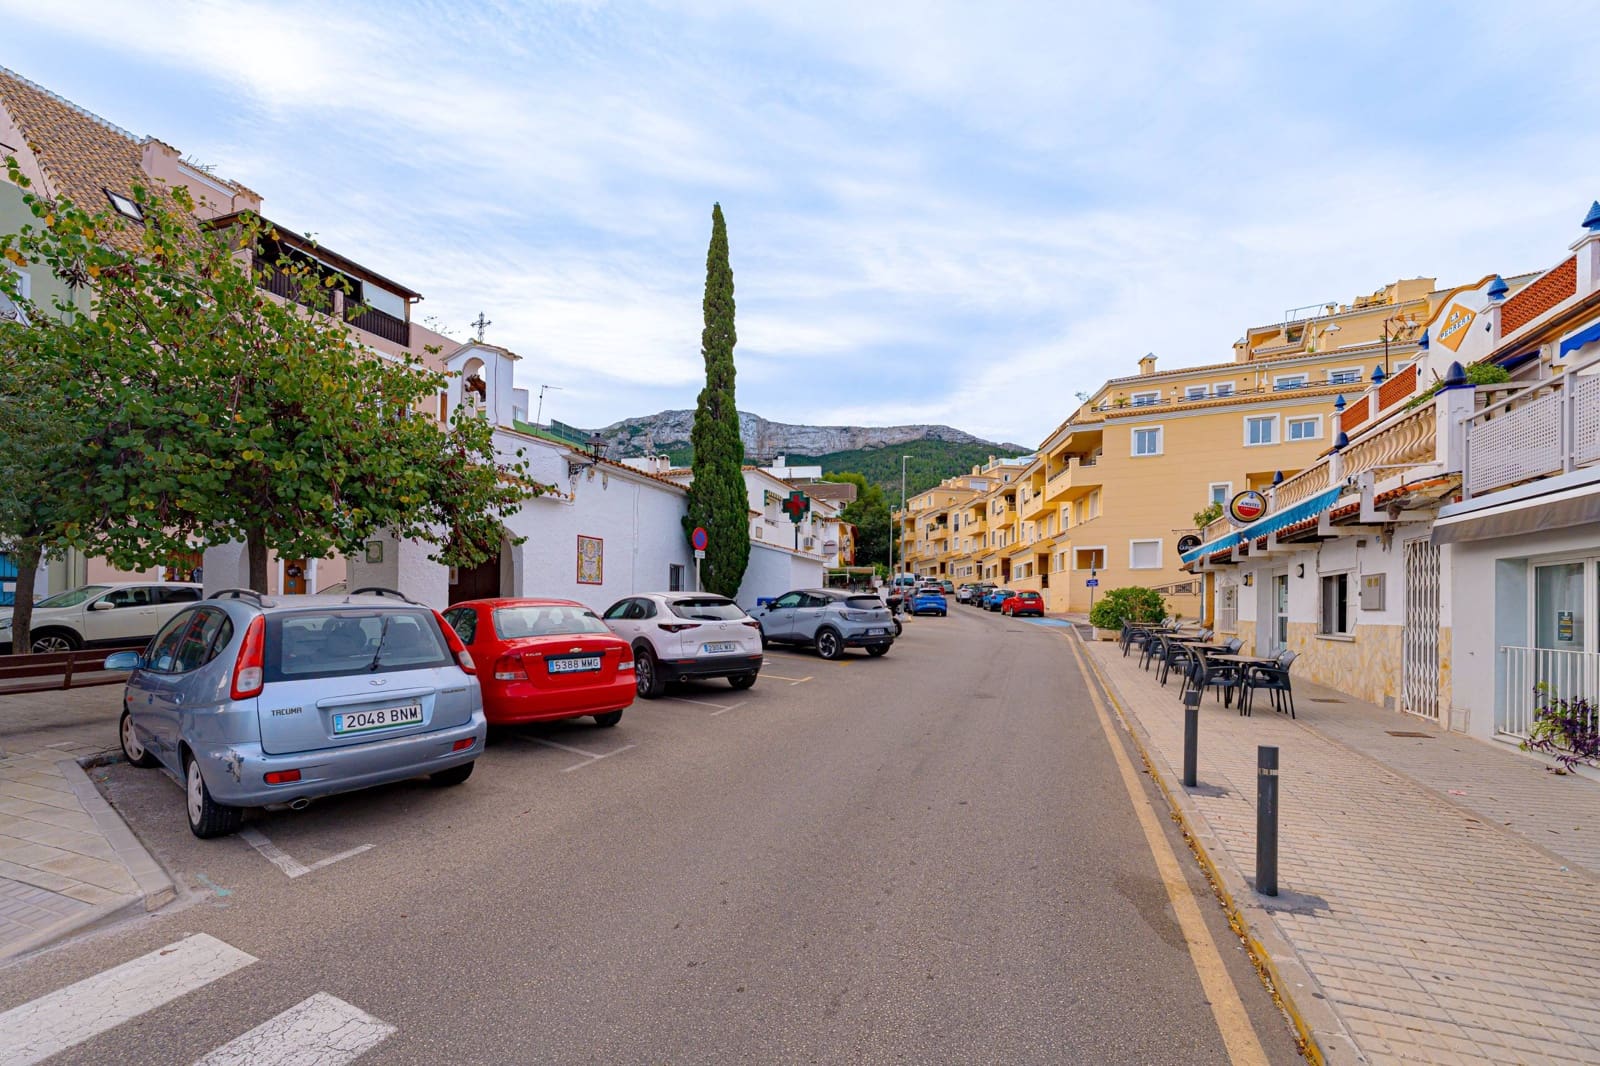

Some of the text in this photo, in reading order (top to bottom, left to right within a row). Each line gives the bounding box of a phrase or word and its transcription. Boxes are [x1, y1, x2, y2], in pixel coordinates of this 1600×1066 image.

[1450, 311, 1459, 322] LA
[1440, 314, 1470, 339] PEDRERA
[555, 658, 599, 670] 5388 MMG
[271, 706, 303, 717] TACUMA
[346, 707, 418, 729] 2048 BNM
